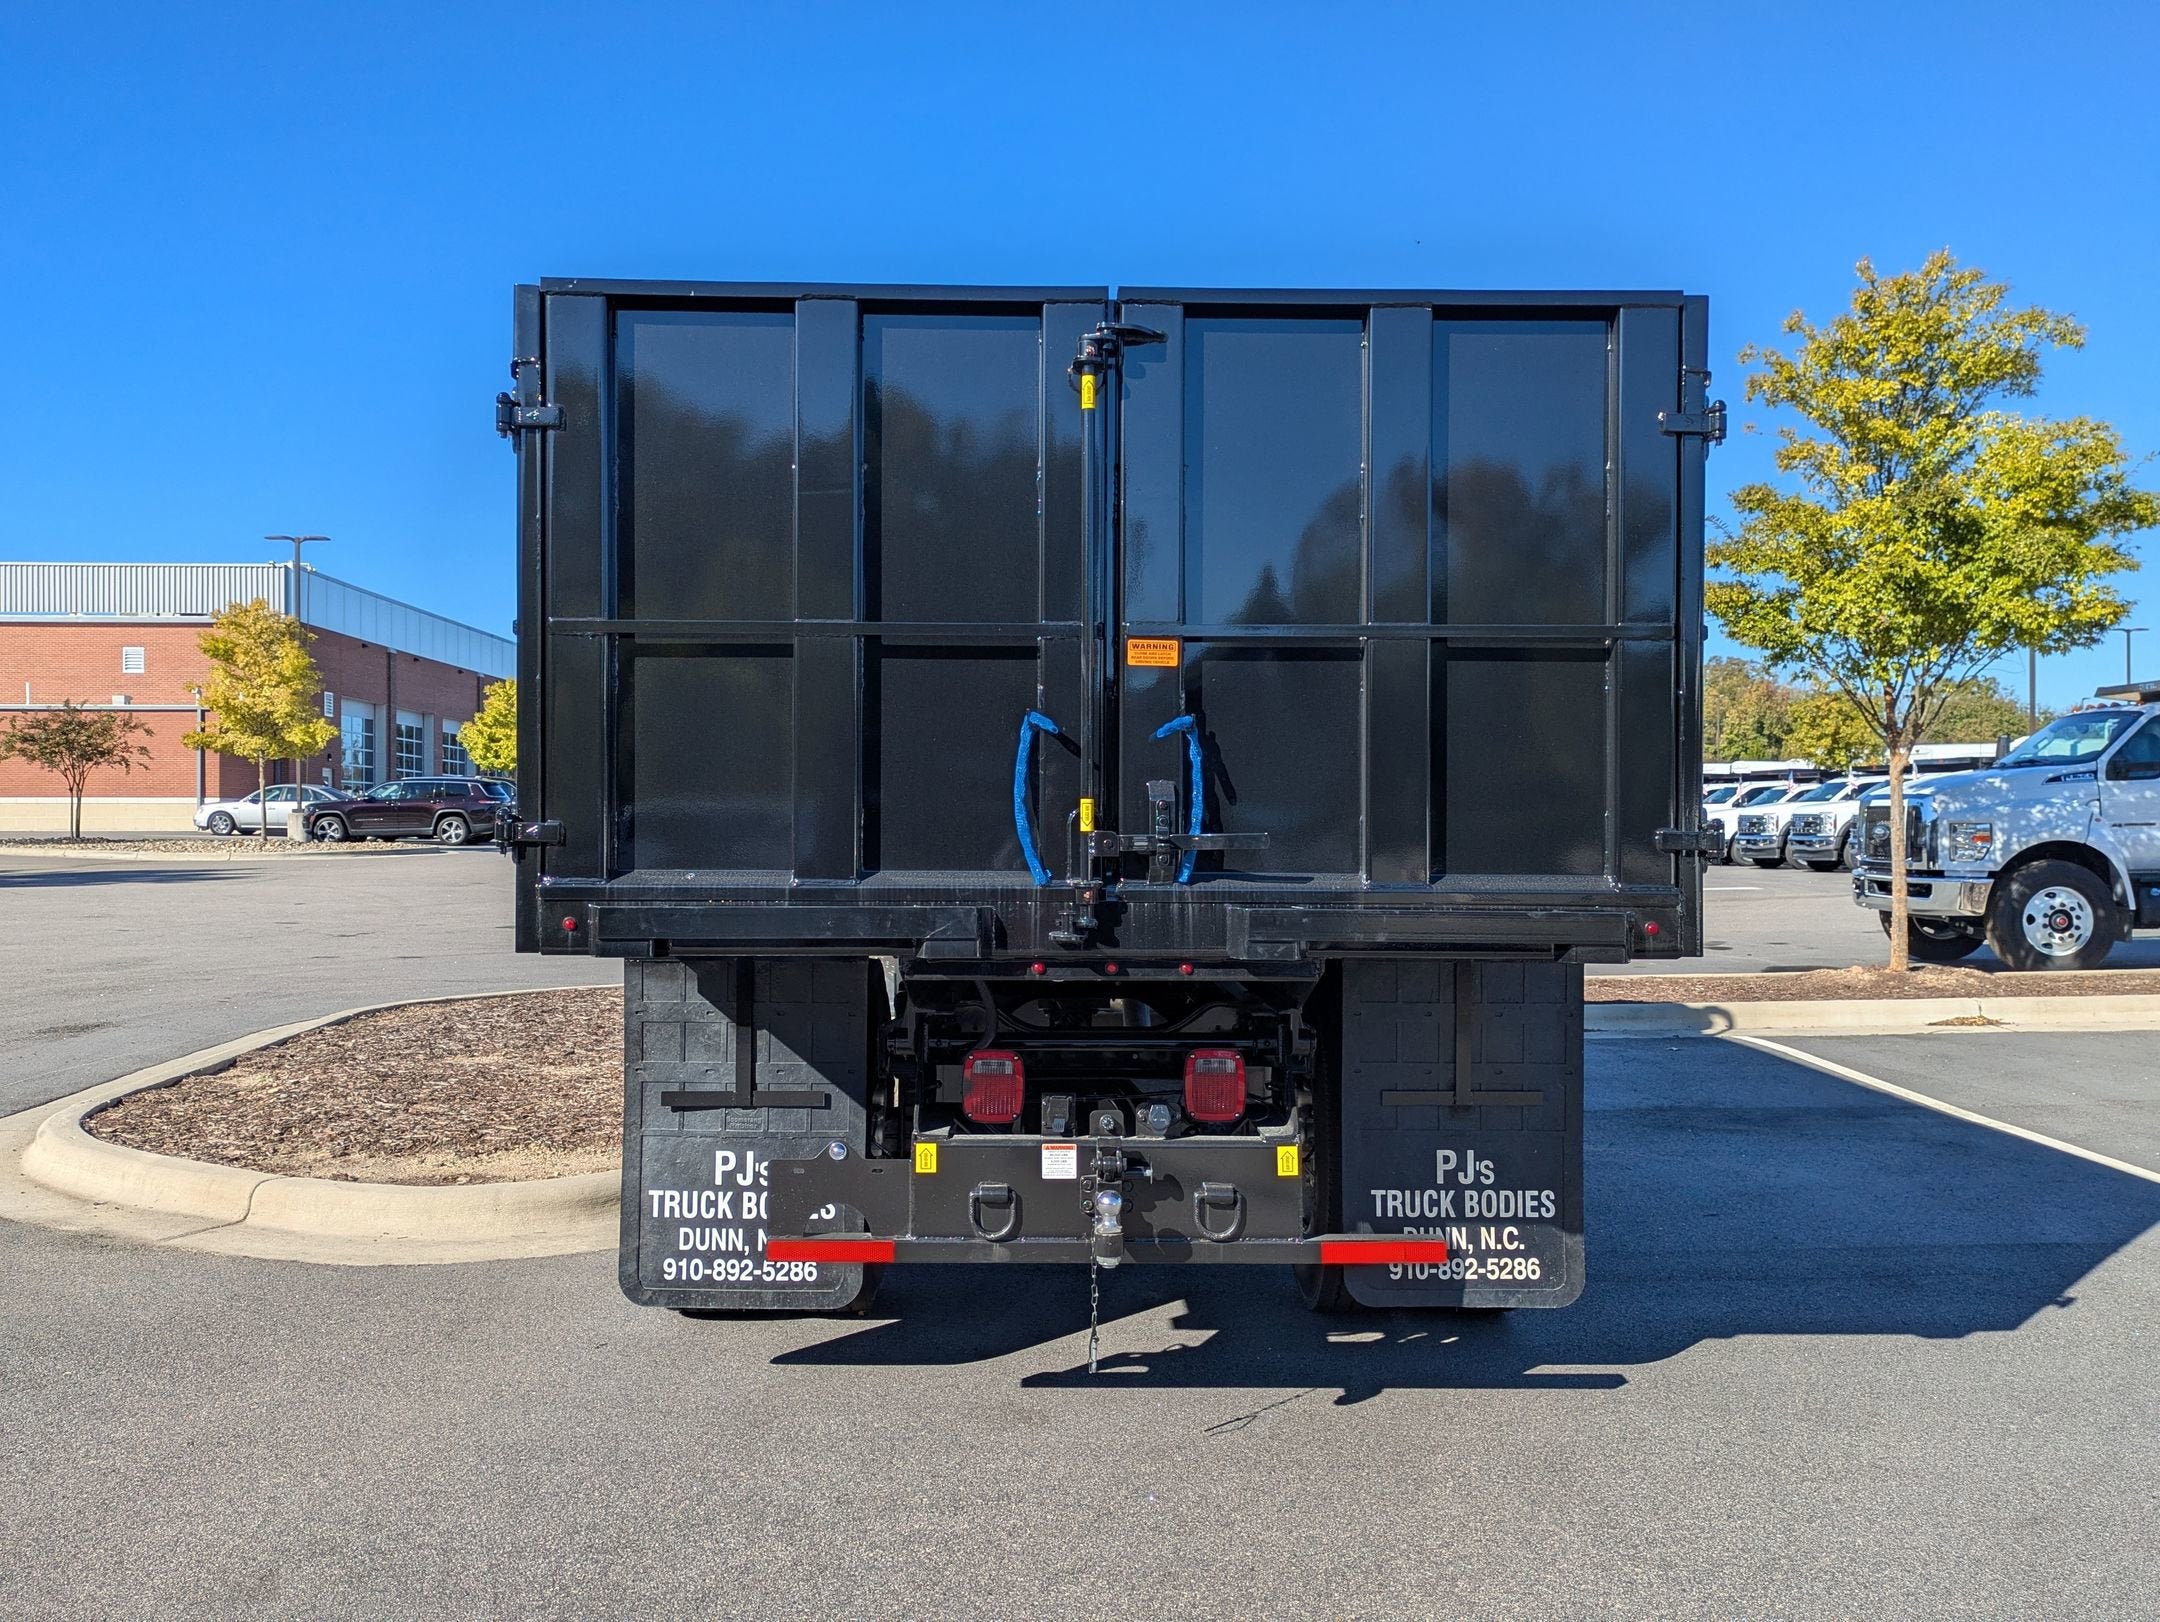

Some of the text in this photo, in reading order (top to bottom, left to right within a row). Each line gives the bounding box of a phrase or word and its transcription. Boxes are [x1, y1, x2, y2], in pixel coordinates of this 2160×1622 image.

[1131, 643, 1174, 651] WARNING
[648, 1190, 733, 1220] TRUCK
[1371, 1189, 1556, 1218] TRUCK BODIES
[679, 1227, 749, 1256] DUNN,
[1480, 1226, 1525, 1250] N.C.
[663, 1258, 818, 1282] 910-892-5286
[1389, 1257, 1541, 1281] 910-892-5286
